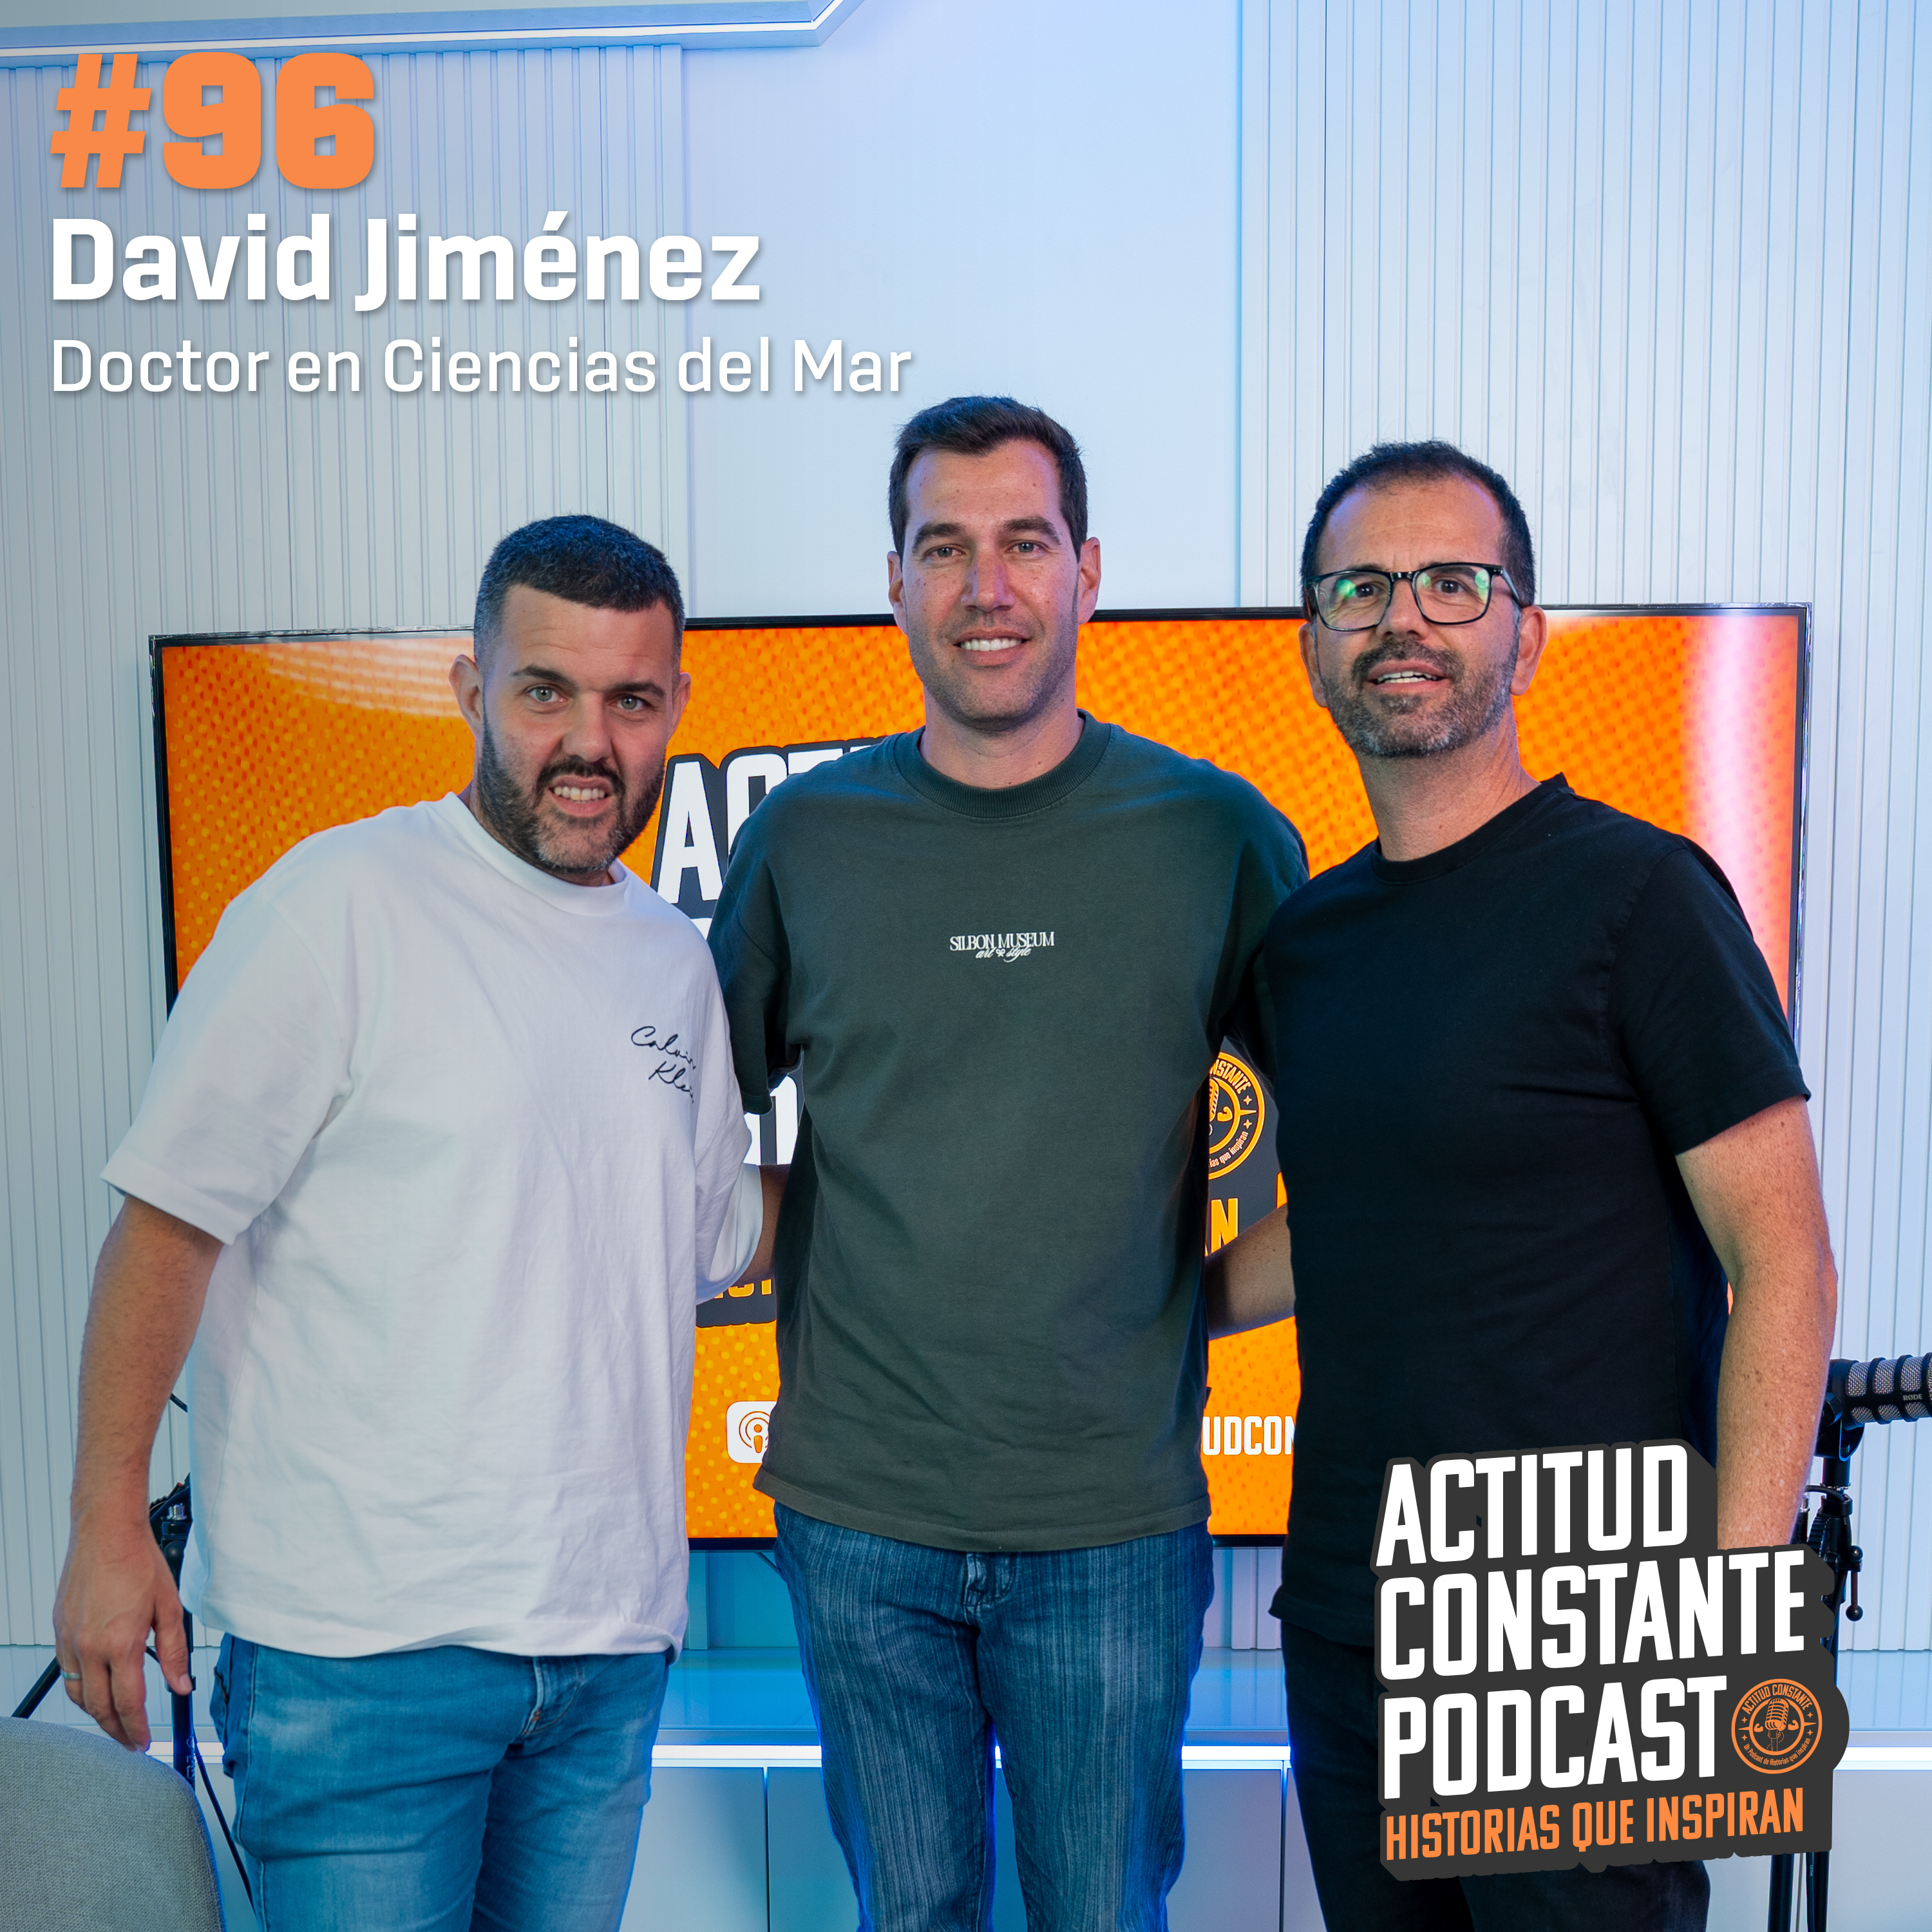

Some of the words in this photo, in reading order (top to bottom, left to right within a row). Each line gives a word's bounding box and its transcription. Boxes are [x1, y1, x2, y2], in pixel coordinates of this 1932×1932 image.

[949, 934, 994, 951] SILBON
[998, 931, 1055, 949] MUSEUM
[975, 947, 997, 959] art
[1003, 945, 1032, 963] style
